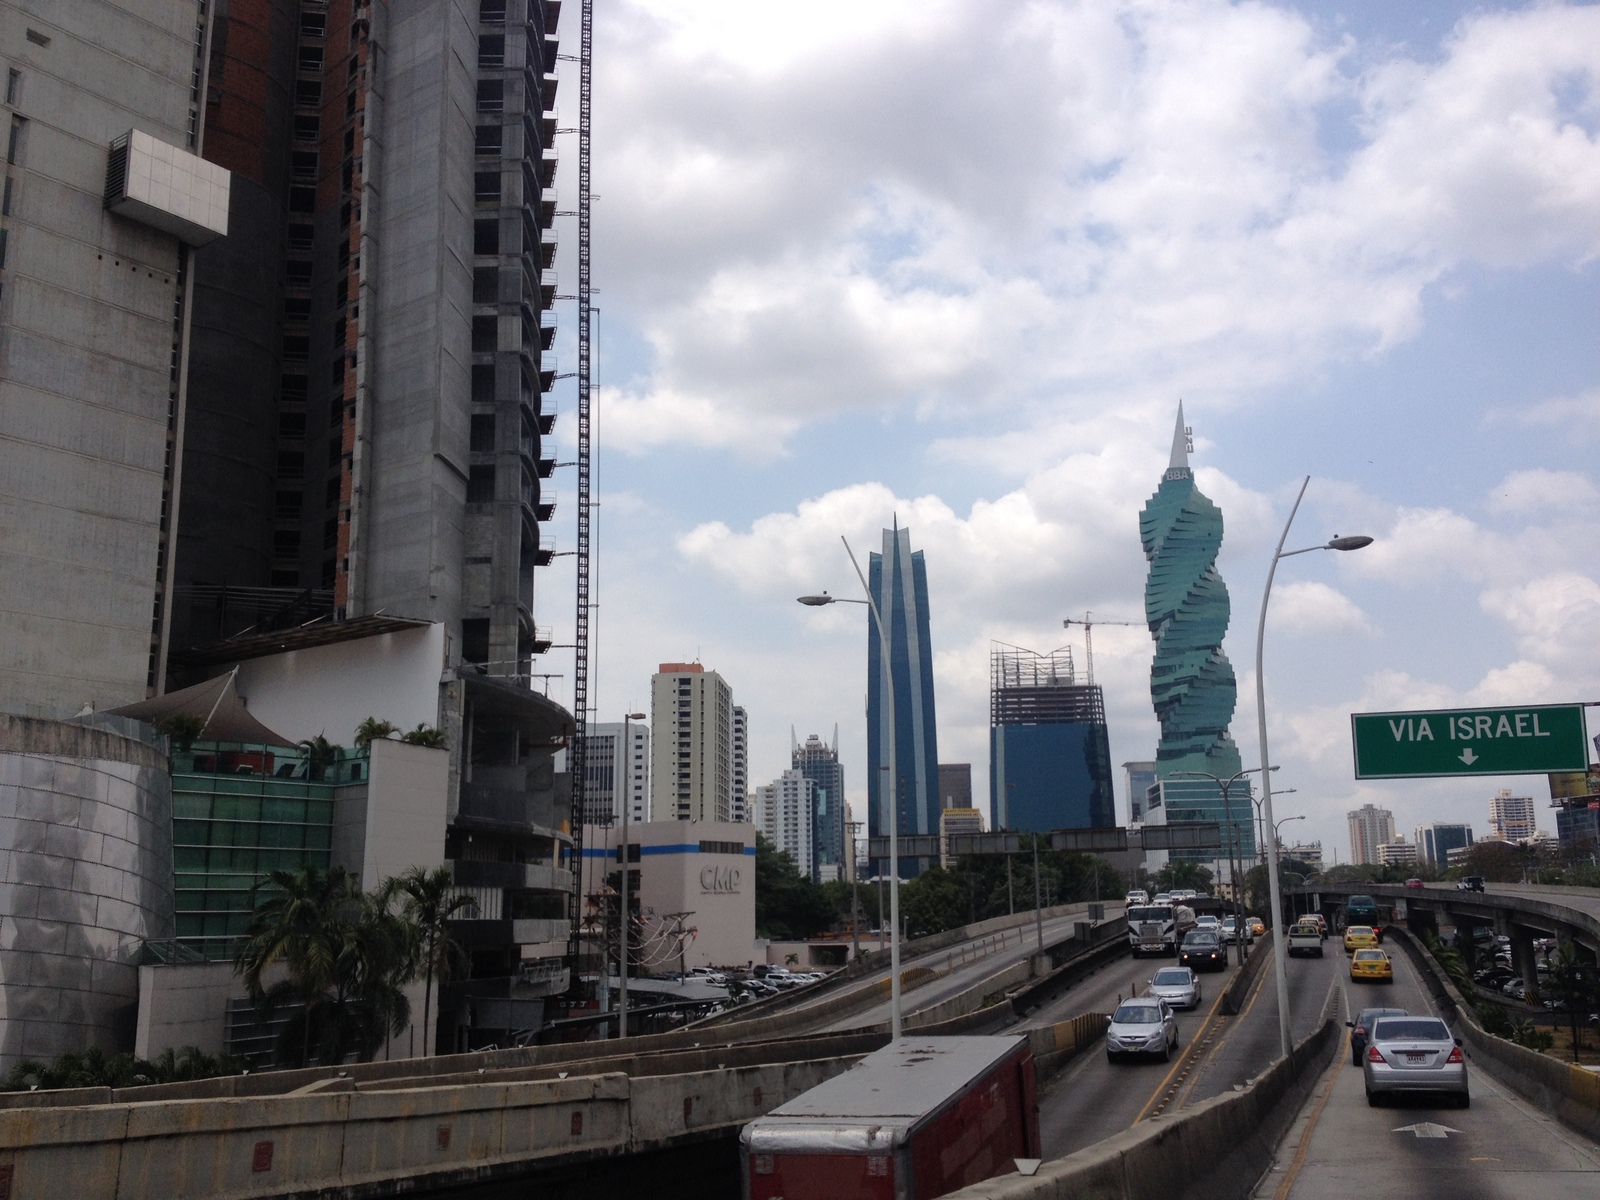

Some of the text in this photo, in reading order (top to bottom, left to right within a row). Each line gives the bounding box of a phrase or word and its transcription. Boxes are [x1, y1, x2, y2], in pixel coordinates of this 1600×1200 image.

[1388, 713, 1550, 742] VIA ISRAEL
[700, 864, 742, 890] CMP
